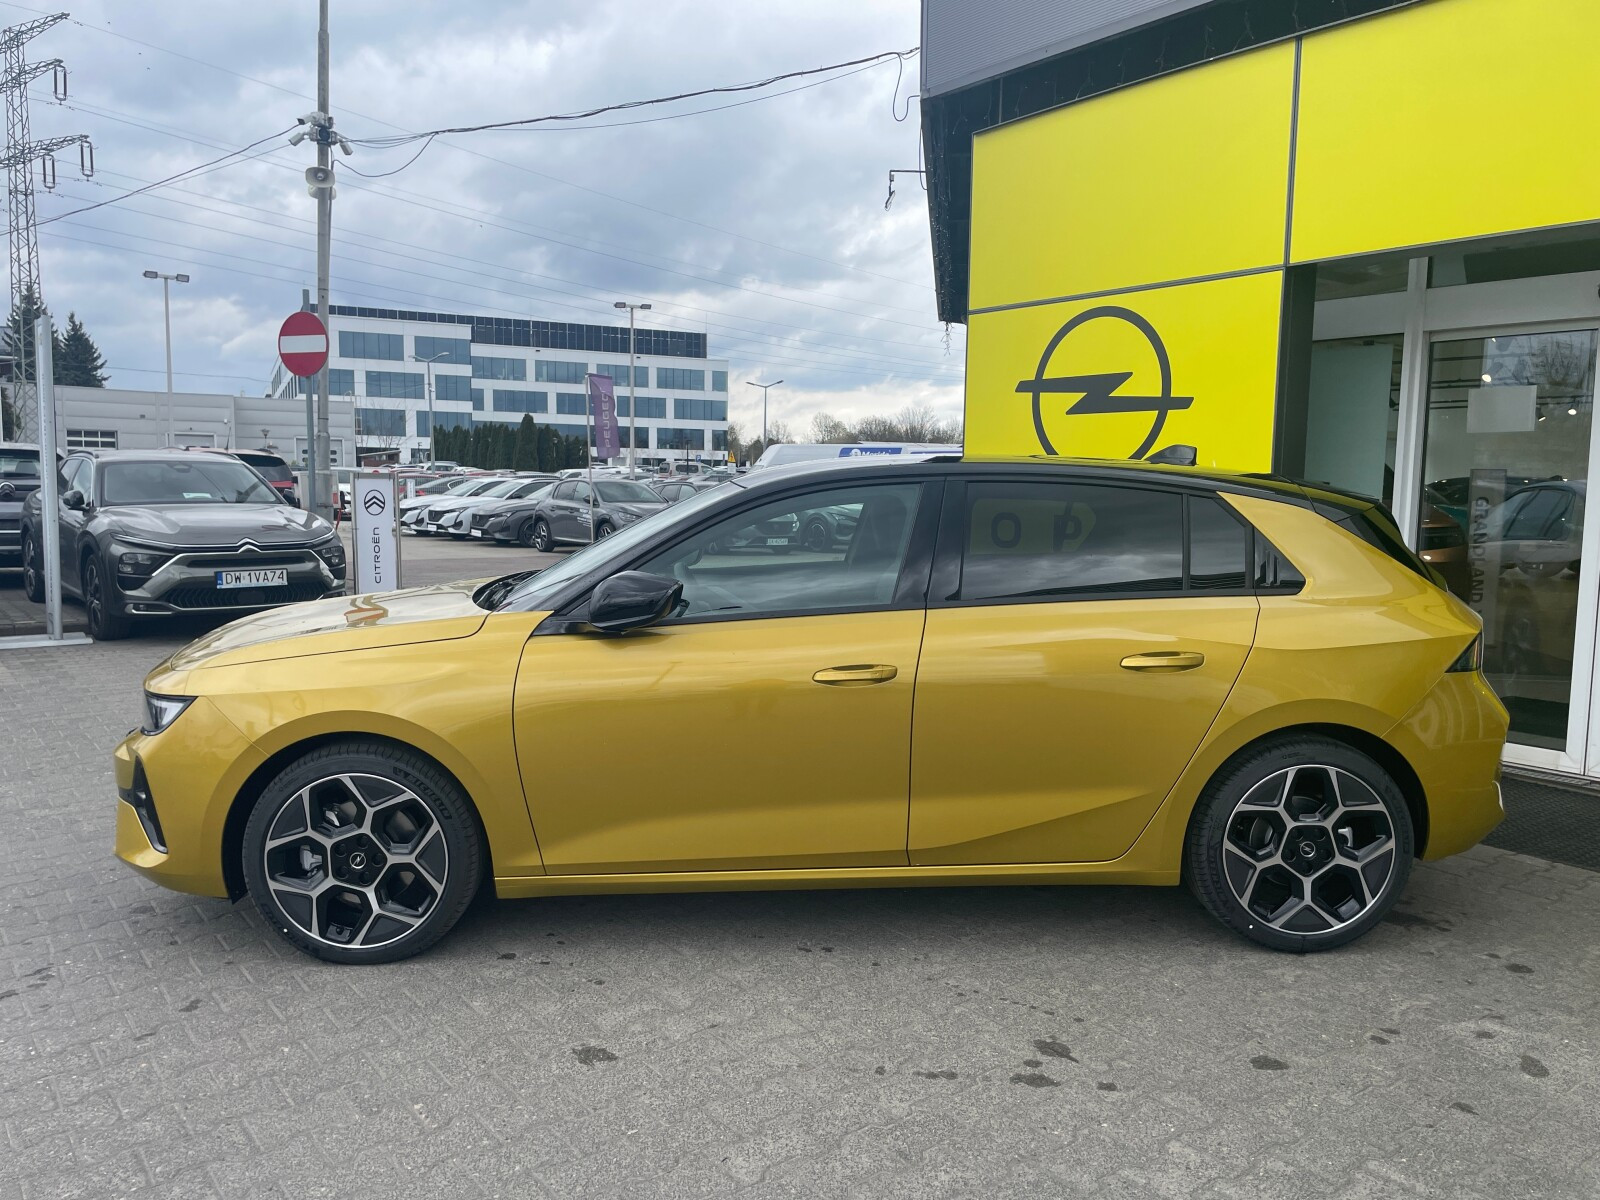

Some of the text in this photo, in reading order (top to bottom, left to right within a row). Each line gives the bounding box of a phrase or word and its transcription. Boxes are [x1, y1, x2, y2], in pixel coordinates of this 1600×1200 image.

[601, 389, 611, 448] PEUGEO
[225, 572, 242, 584] DW
[247, 570, 285, 583] 1VA74
[372, 527, 381, 584] CITROËN
